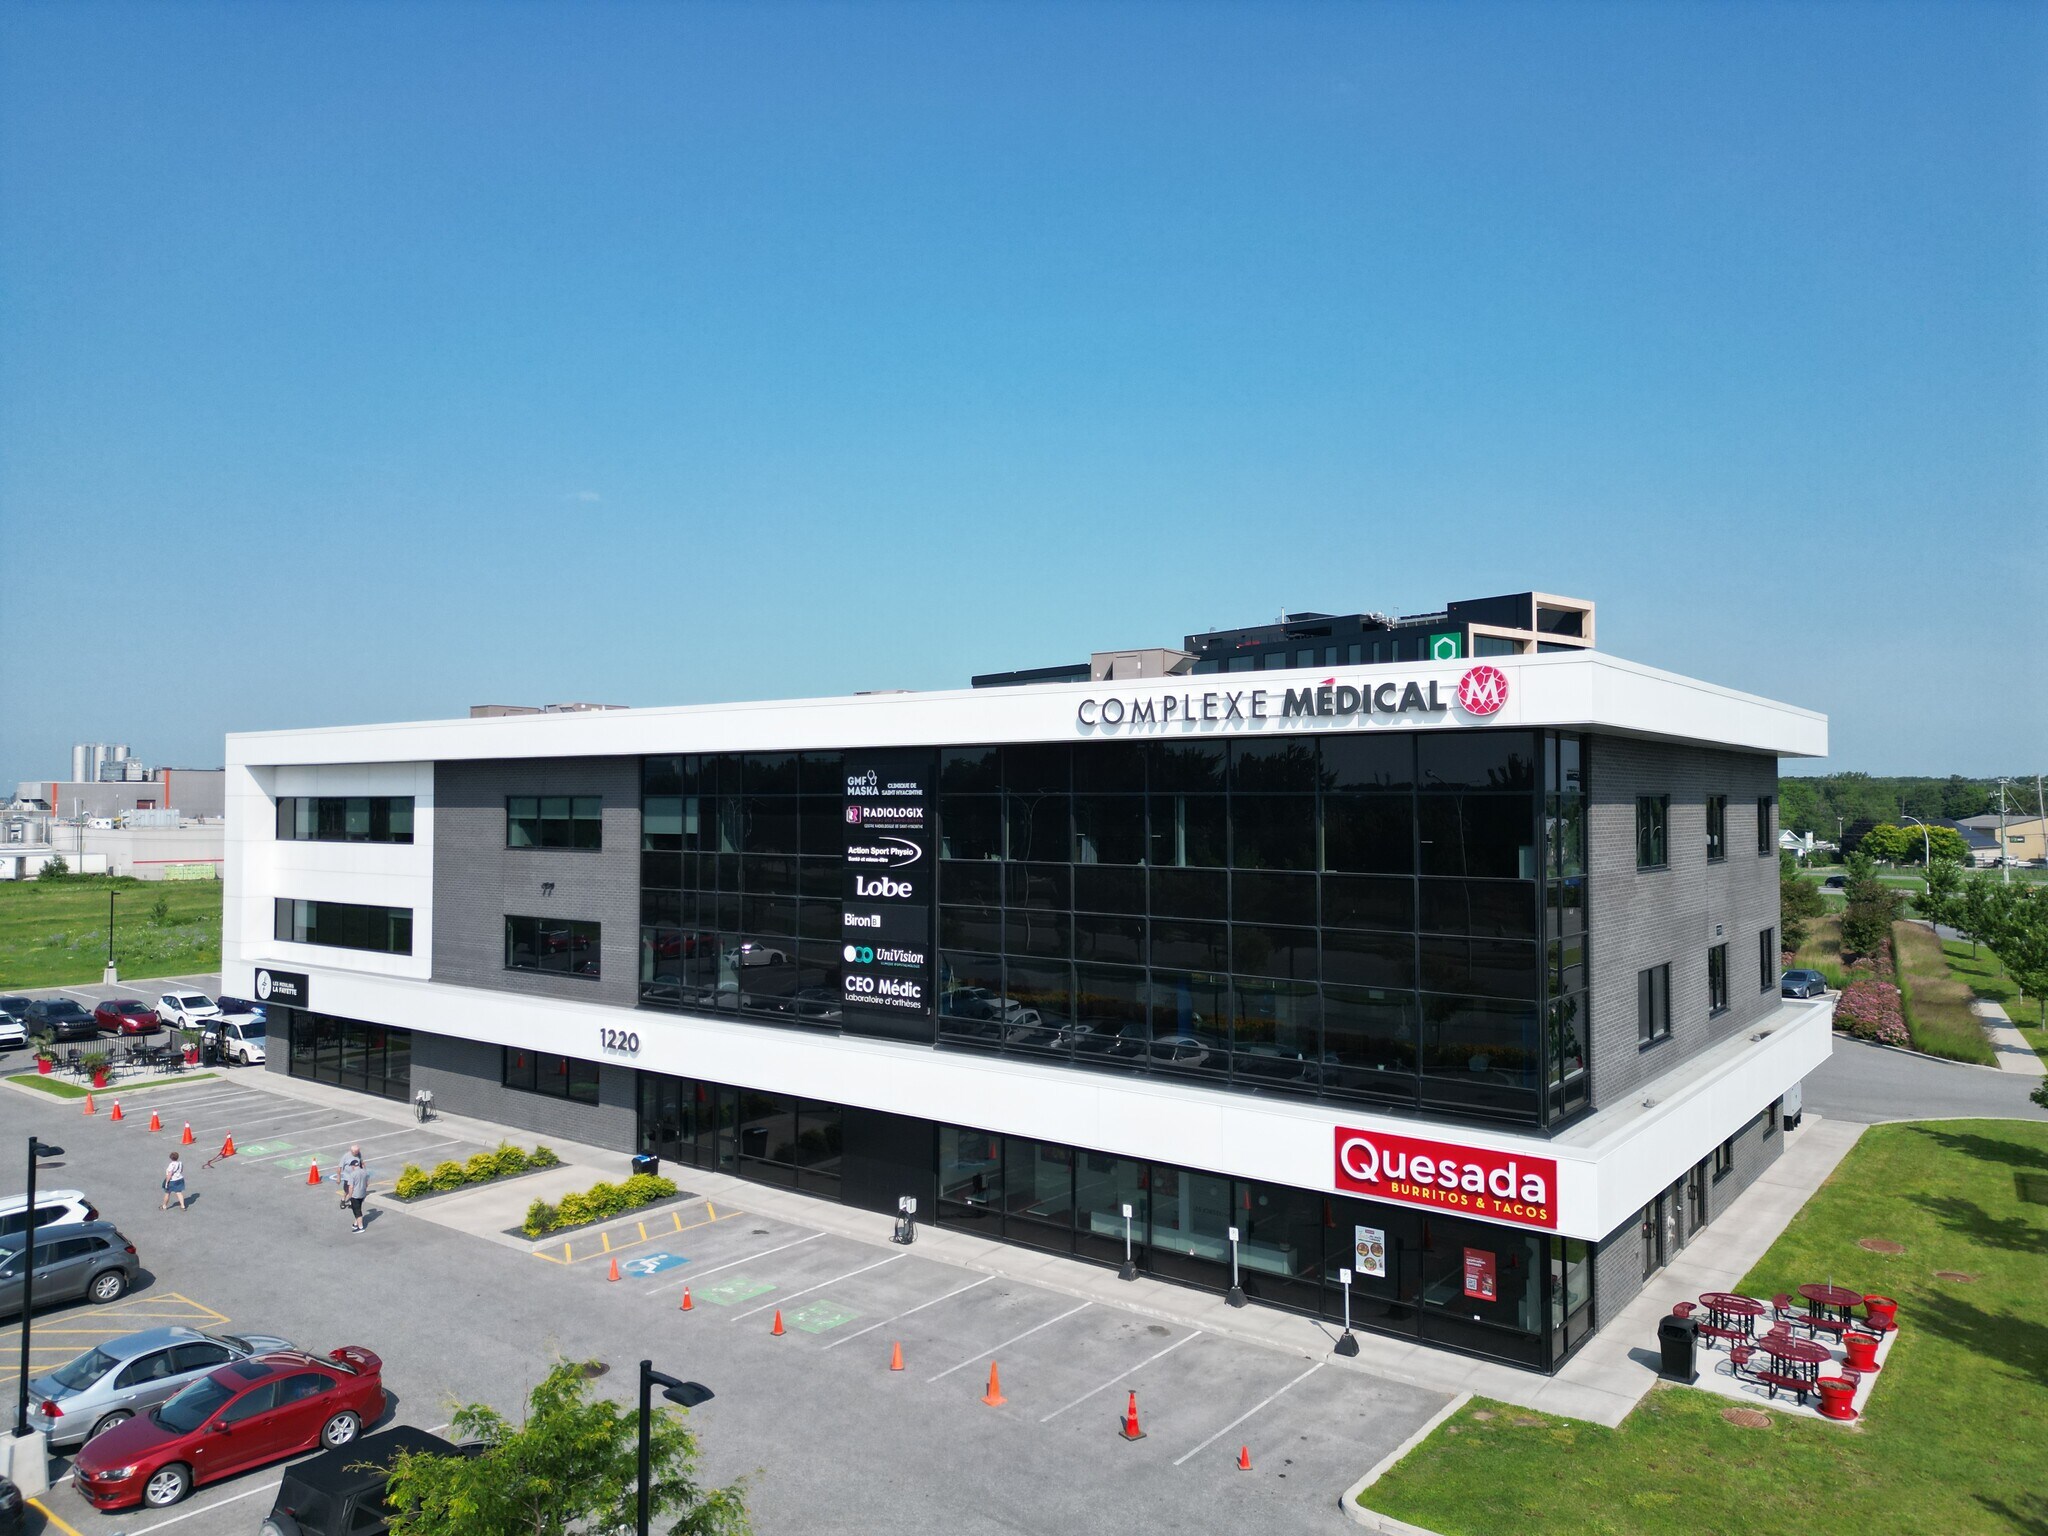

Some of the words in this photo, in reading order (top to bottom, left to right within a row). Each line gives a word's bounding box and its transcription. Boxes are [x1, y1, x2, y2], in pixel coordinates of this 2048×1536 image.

[1078, 690, 1267, 726] COMPLEXE
[1283, 677, 1447, 717] MÉDICAL
[847, 776, 867, 786] GMF
[847, 786, 879, 796] MASKA
[863, 807, 923, 818] RADIOLOGIX
[848, 846, 870, 854] Action
[870, 847, 889, 856] Sport
[890, 847, 914, 857] Physio
[856, 875, 913, 898] Lobe
[844, 913, 871, 927] Biron
[876, 948, 924, 964] UniVision
[845, 975, 874, 993] CEO
[878, 978, 921, 998] Médic
[845, 993, 884, 1004] Laboratoire
[884, 997, 921, 1009] d'orthèses
[600, 1028, 640, 1053] 1220
[1340, 1137, 1546, 1204] Quesada
[1391, 1181, 1468, 1206] BURRITOS
[1475, 1197, 1485, 1209] &
[1494, 1200, 1548, 1220] TACOS
